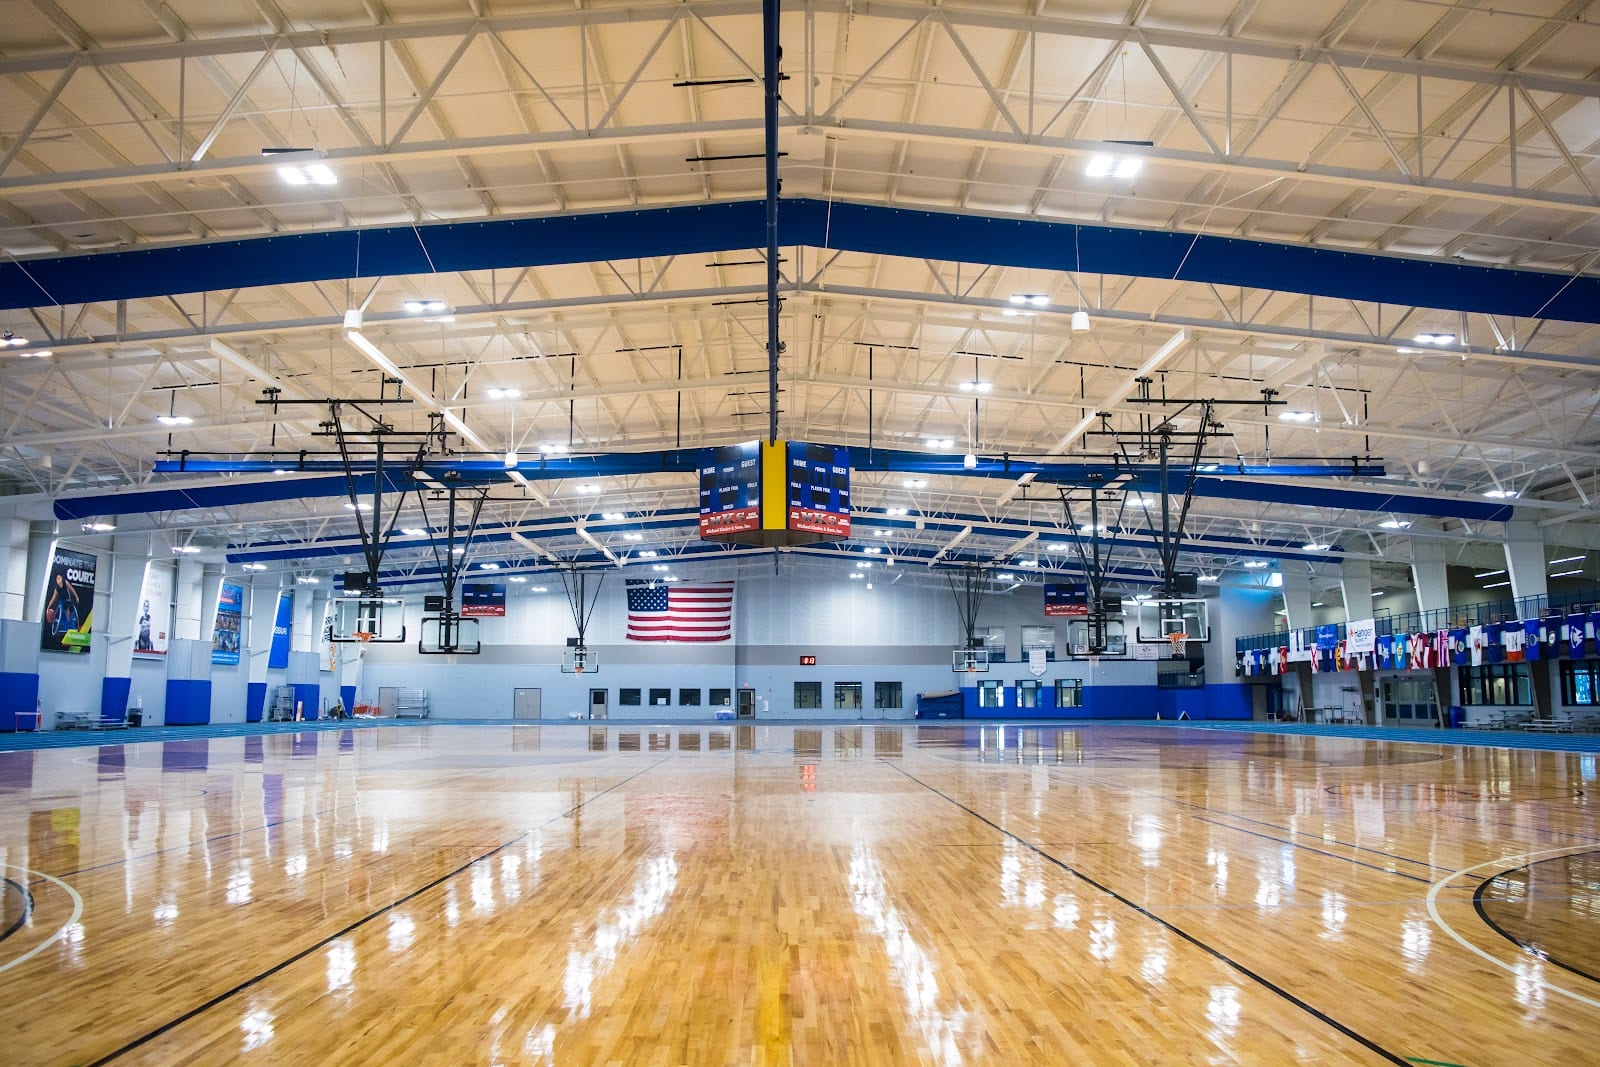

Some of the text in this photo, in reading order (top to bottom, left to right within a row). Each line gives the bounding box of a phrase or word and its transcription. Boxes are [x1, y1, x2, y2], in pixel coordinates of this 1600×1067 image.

[741, 459, 756, 468] GUEST
[793, 459, 807, 468] HOME
[832, 465, 847, 475] GUEST
[710, 512, 745, 525] MKS
[801, 511, 837, 525] MKS
[84, 560, 95, 570] THE
[66, 568, 95, 584] COURT.
